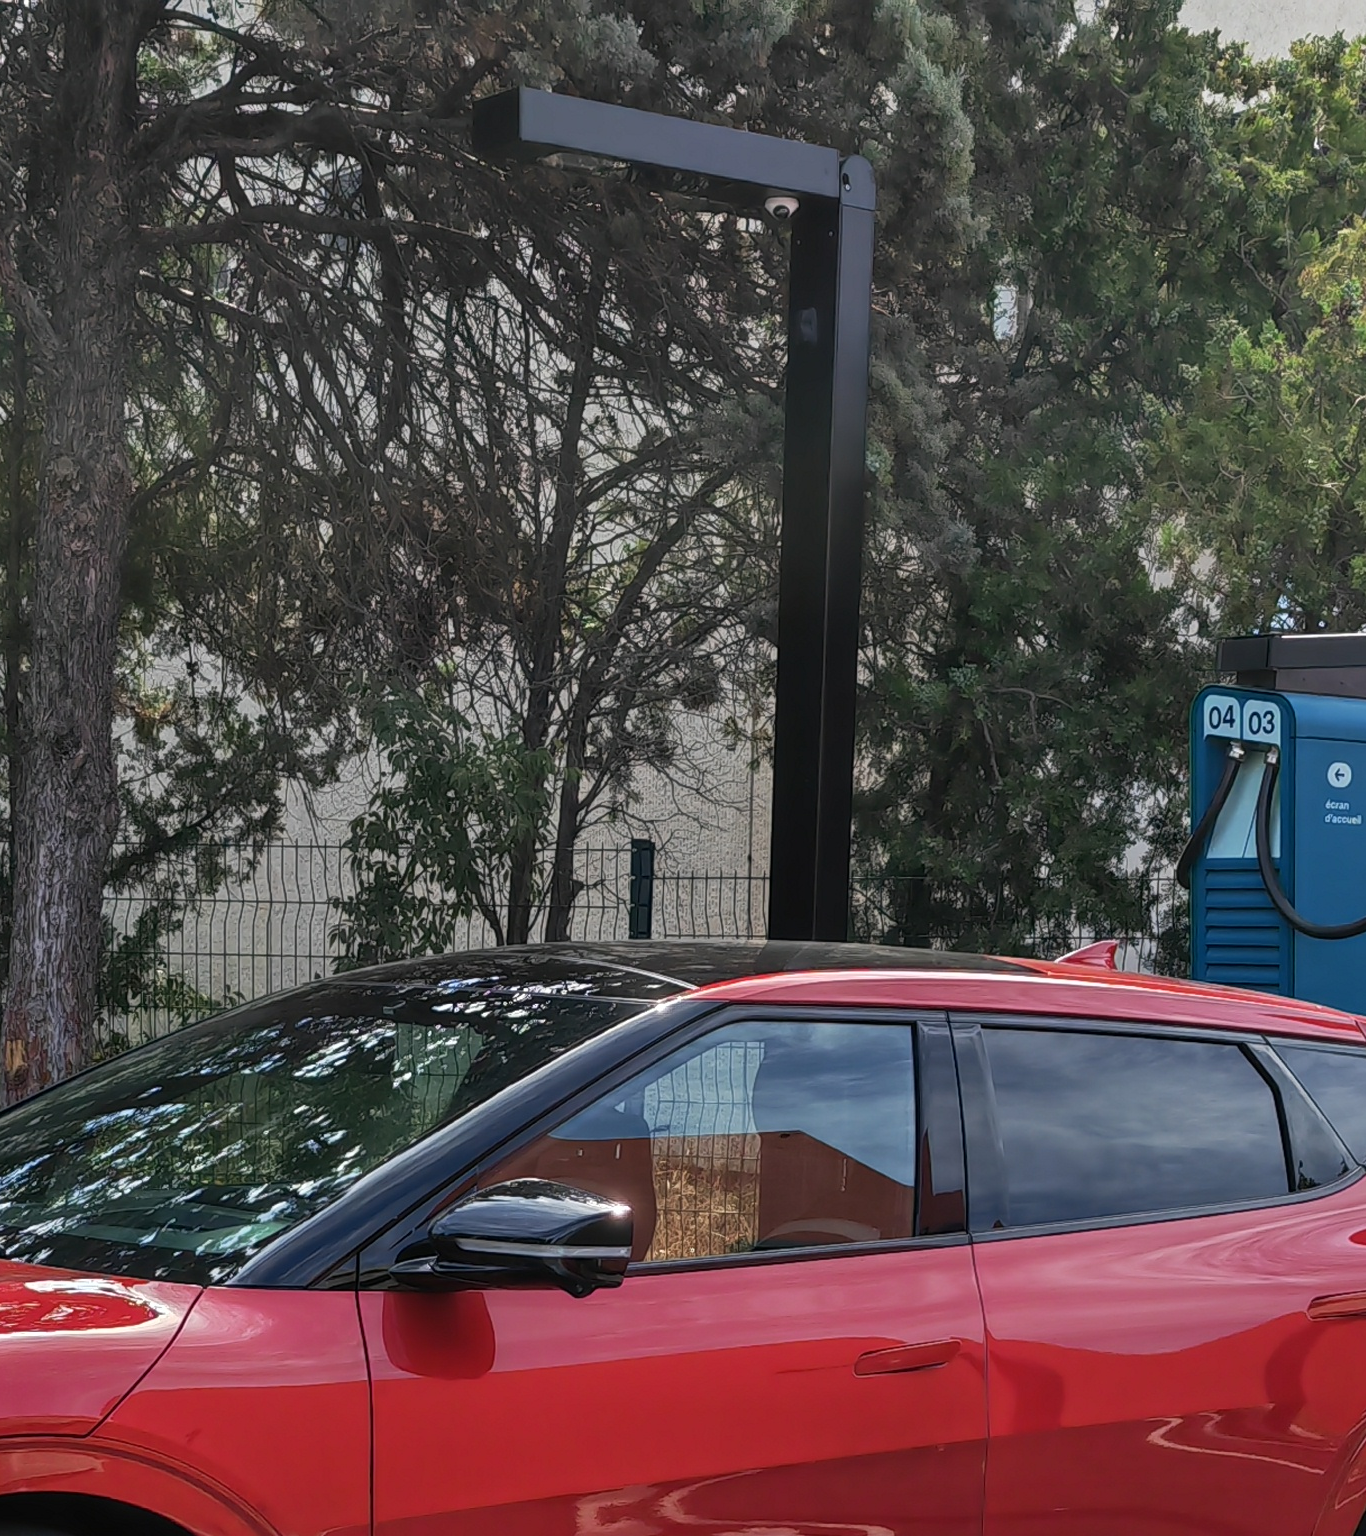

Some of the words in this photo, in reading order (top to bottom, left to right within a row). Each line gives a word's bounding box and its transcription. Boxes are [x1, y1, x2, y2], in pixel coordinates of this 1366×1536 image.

[1208, 704, 1236, 730] 04
[1248, 710, 1275, 735] 03
[1325, 800, 1350, 811] écran
